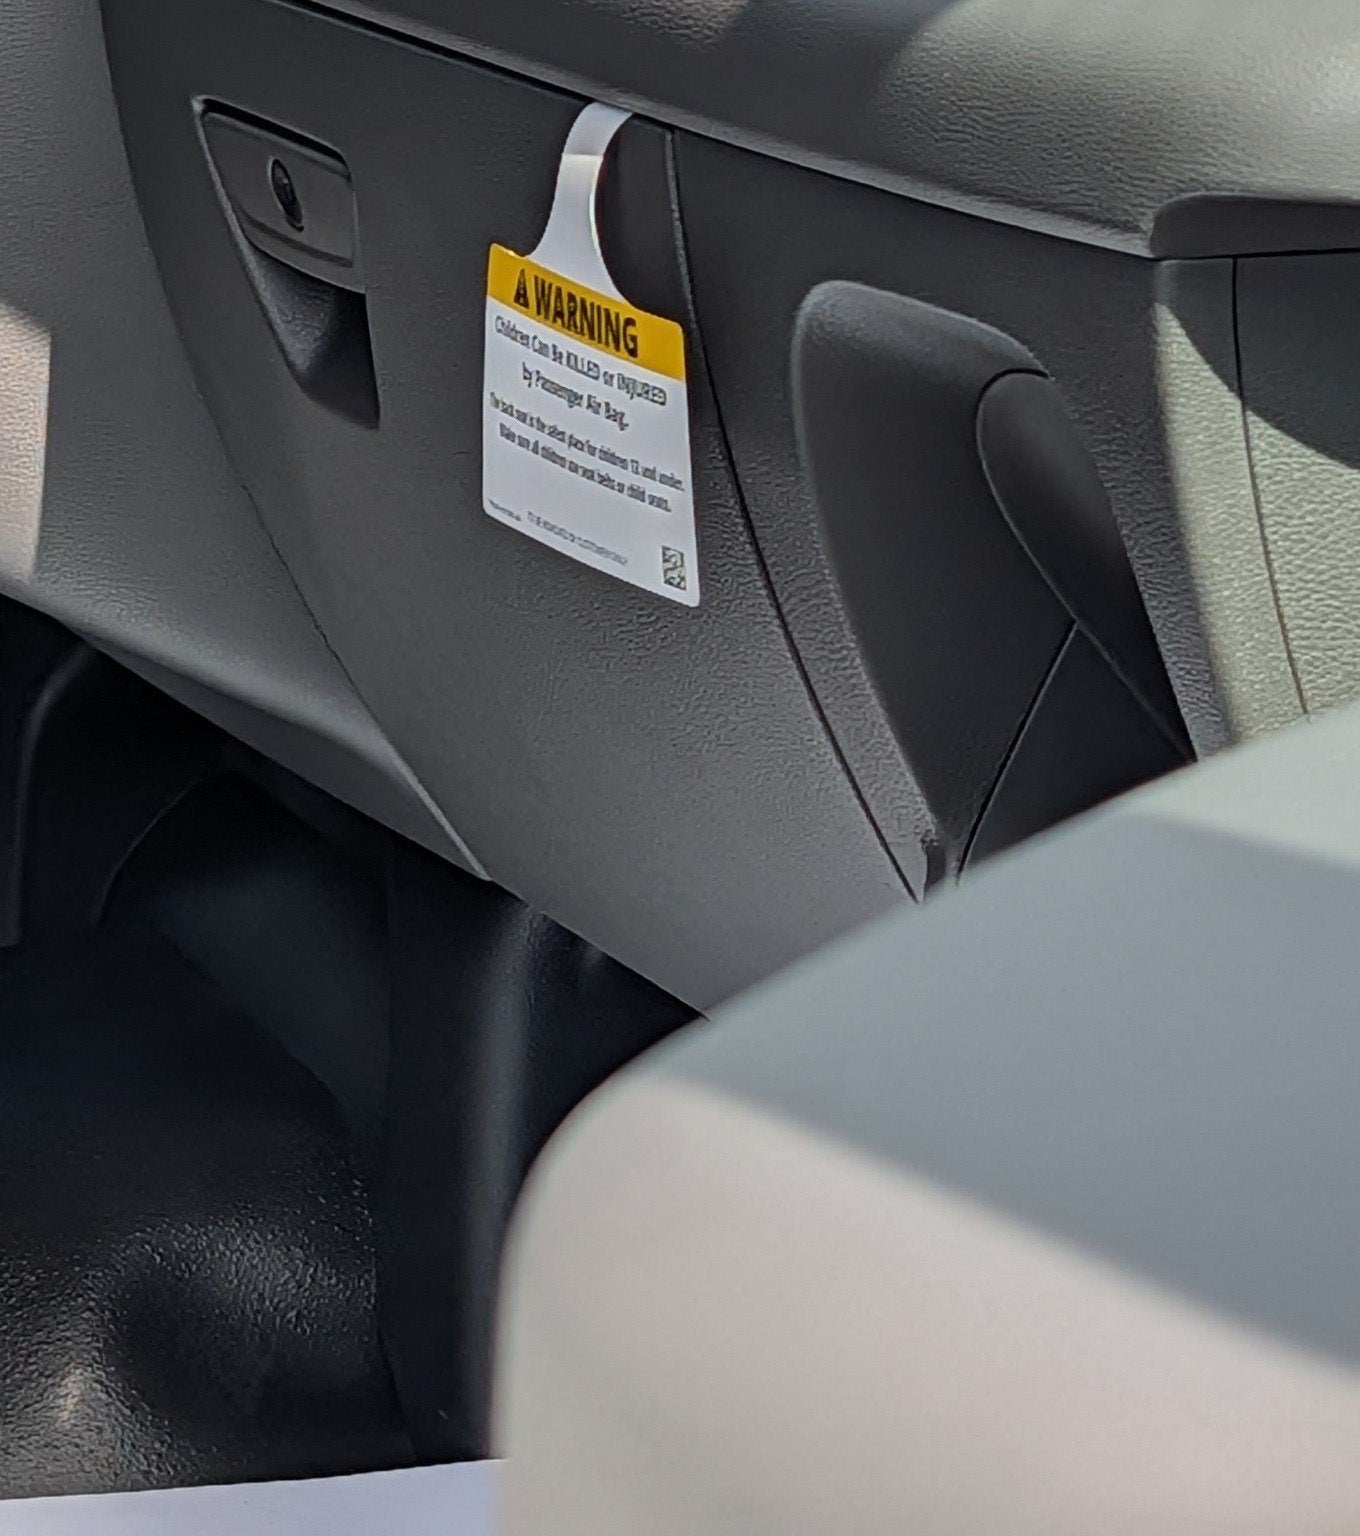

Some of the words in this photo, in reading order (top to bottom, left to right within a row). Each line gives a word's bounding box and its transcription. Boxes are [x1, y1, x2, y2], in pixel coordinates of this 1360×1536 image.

[534, 275, 638, 358] WARNING
[495, 315, 530, 348] Children
[532, 335, 549, 358] Can
[566, 350, 600, 380] KILLED
[603, 371, 614, 387] or
[617, 373, 667, 406] INJURED
[522, 362, 532, 388] by
[586, 394, 601, 415] Air
